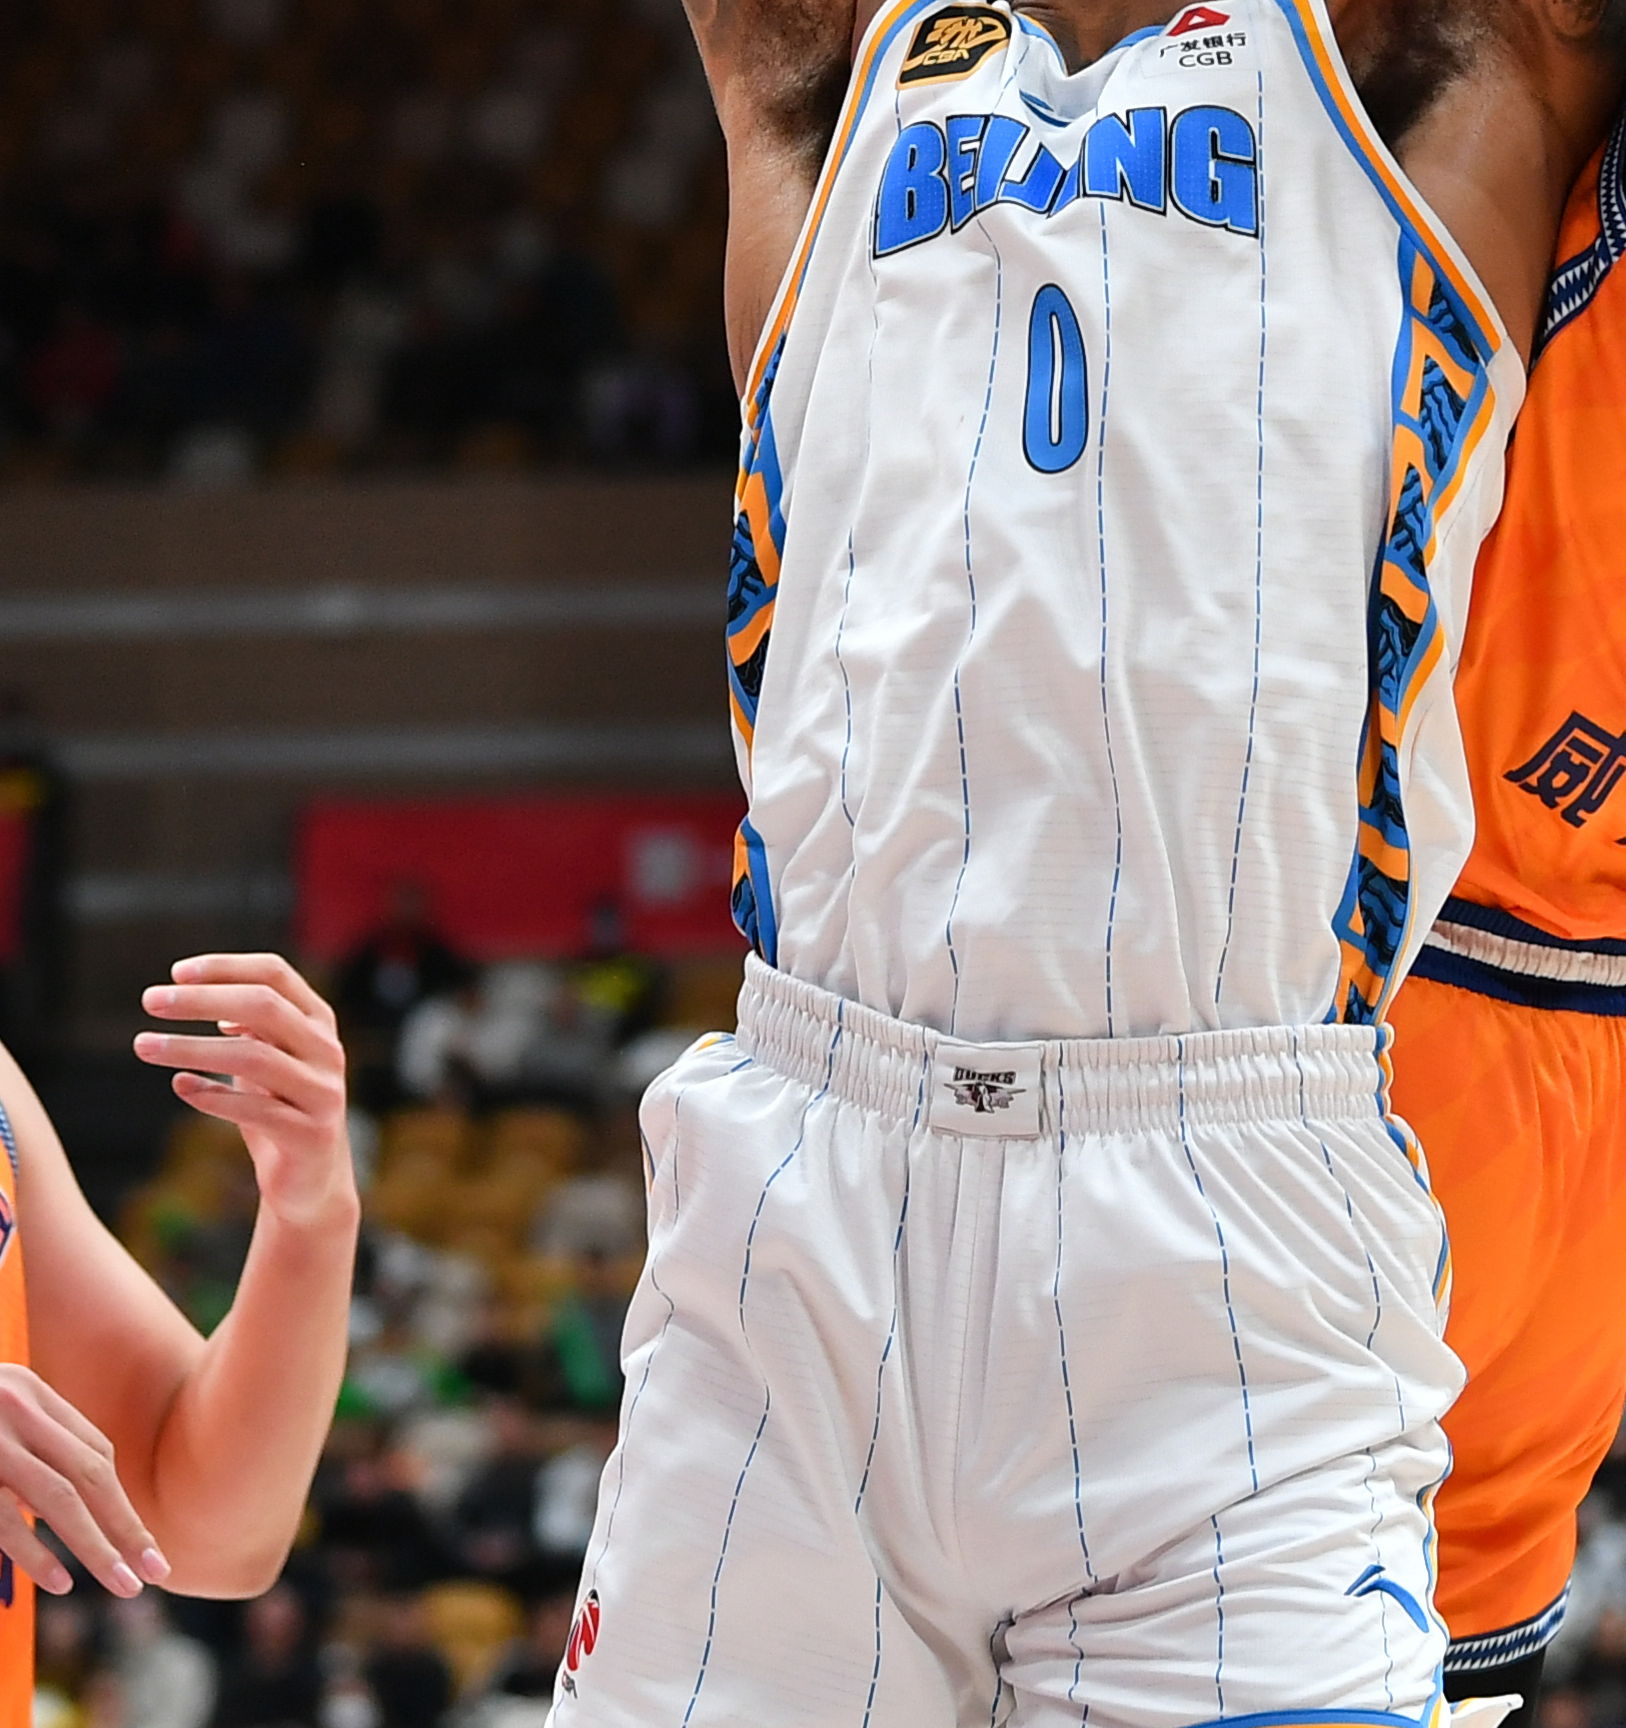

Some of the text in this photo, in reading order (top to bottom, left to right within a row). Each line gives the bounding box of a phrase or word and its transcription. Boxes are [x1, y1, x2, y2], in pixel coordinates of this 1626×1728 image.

[1160, 32, 1246, 58] 广发银行
[922, 49, 970, 66] CBA
[1179, 51, 1233, 68] CGB
[1022, 282, 1090, 476] 0
[953, 1065, 1016, 1085] DUCKS
